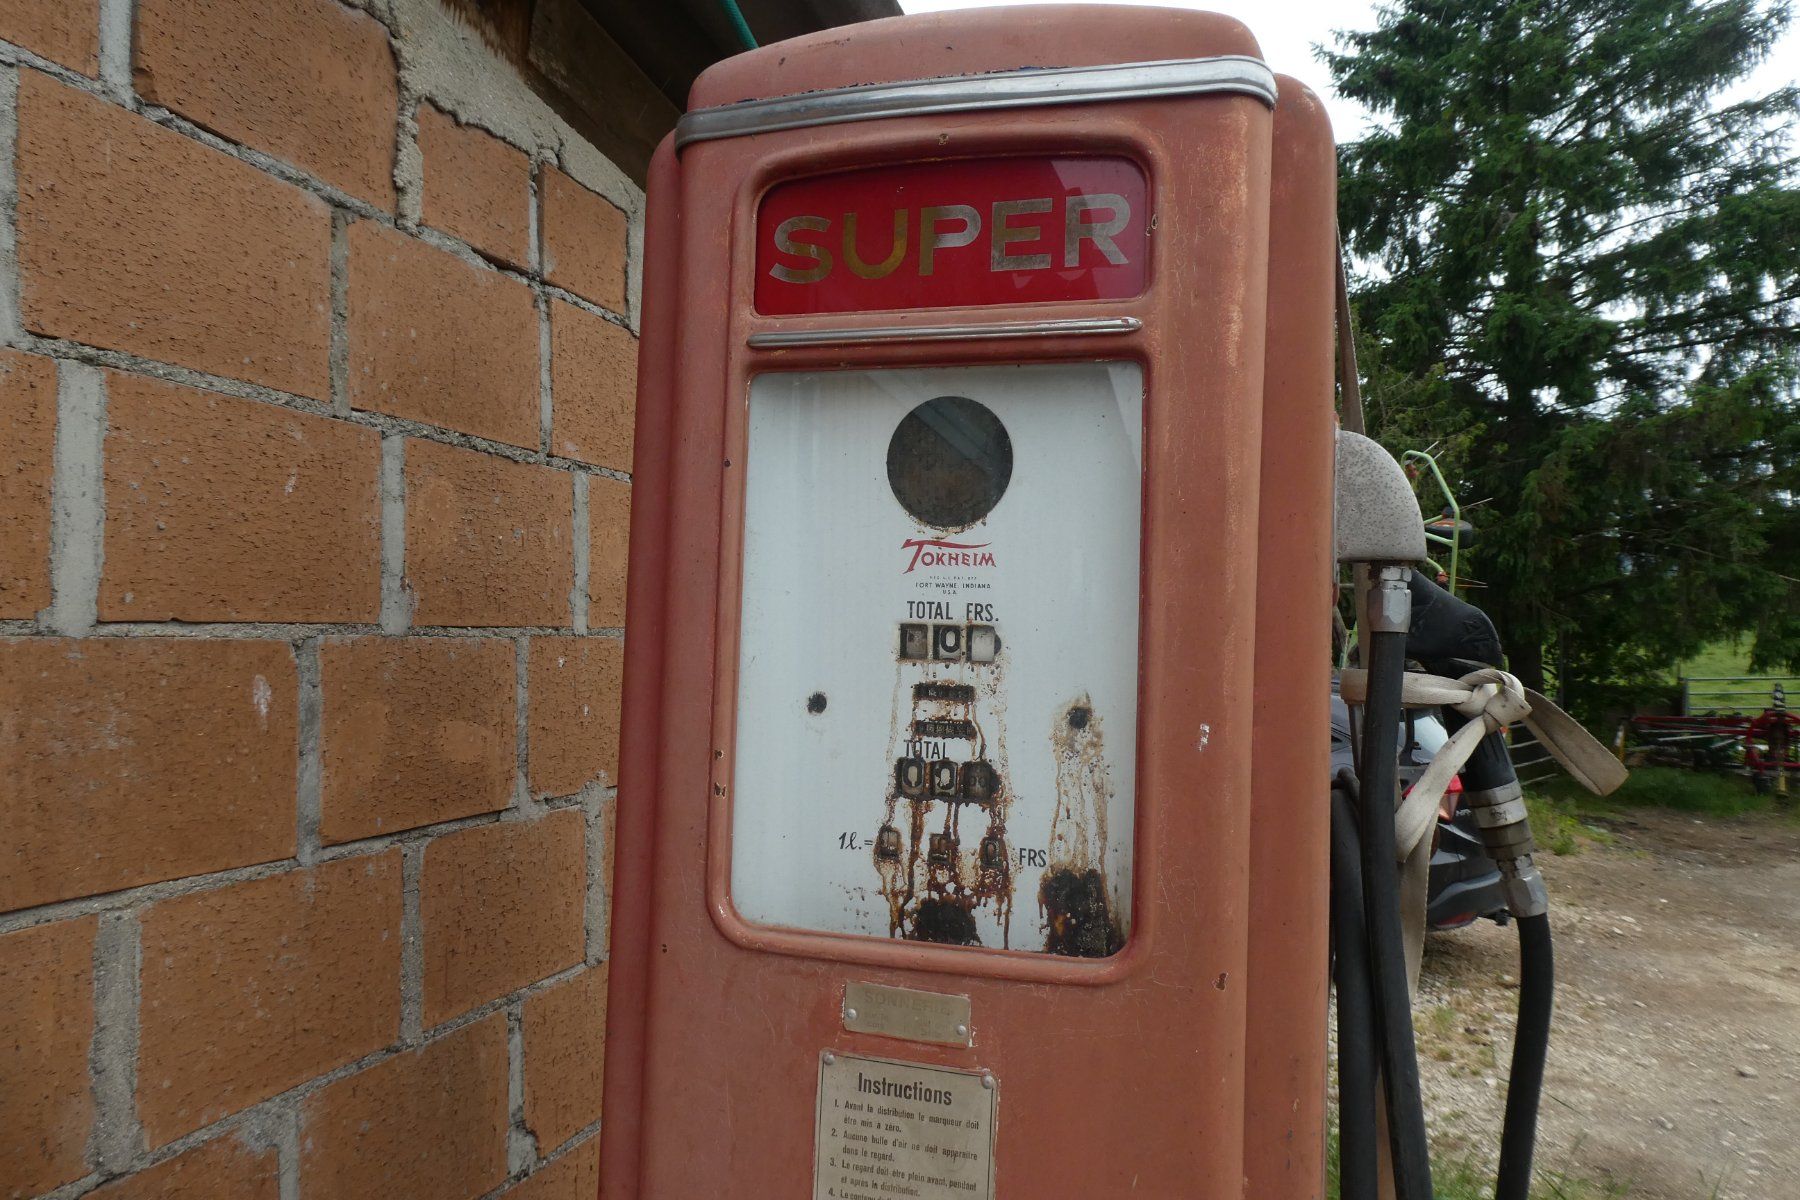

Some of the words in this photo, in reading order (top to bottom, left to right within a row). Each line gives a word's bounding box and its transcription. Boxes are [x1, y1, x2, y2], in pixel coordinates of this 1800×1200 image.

[768, 193, 1132, 284] SUPER
[907, 601, 953, 620] TOTAL
[966, 603, 998, 622] FRS.
[904, 740, 950, 760] TOTAL
[1019, 848, 1047, 868] FRS
[858, 1072, 952, 1106] Instructions
[845, 1101, 863, 1111] Avant
[867, 1104, 874, 1112] la
[878, 1105, 914, 1120] distribution
[918, 1112, 924, 1121] le
[929, 1116, 962, 1128] marqueur
[966, 1120, 979, 1130] doit
[860, 1118, 873, 1127] mis
[832, 1128, 837, 1137] 2.
[843, 1130, 868, 1142] Aucune
[872, 1134, 888, 1145] bulle
[892, 1139, 908, 1149] d'air
[925, 1144, 938, 1153] doit
[842, 1145, 858, 1155] dans
[862, 1148, 868, 1156] le
[870, 1150, 895, 1162] regard.
[830, 1157, 836, 1167] 3.
[842, 1159, 850, 1169] Le
[852, 1163, 874, 1174] regard
[876, 1166, 889, 1176] doit
[908, 1172, 924, 1182] plein
[949, 1180, 976, 1191] pendant
[828, 1187, 835, 1197] 4.
[840, 1189, 848, 1199] Le
[872, 1180, 878, 1189] la
